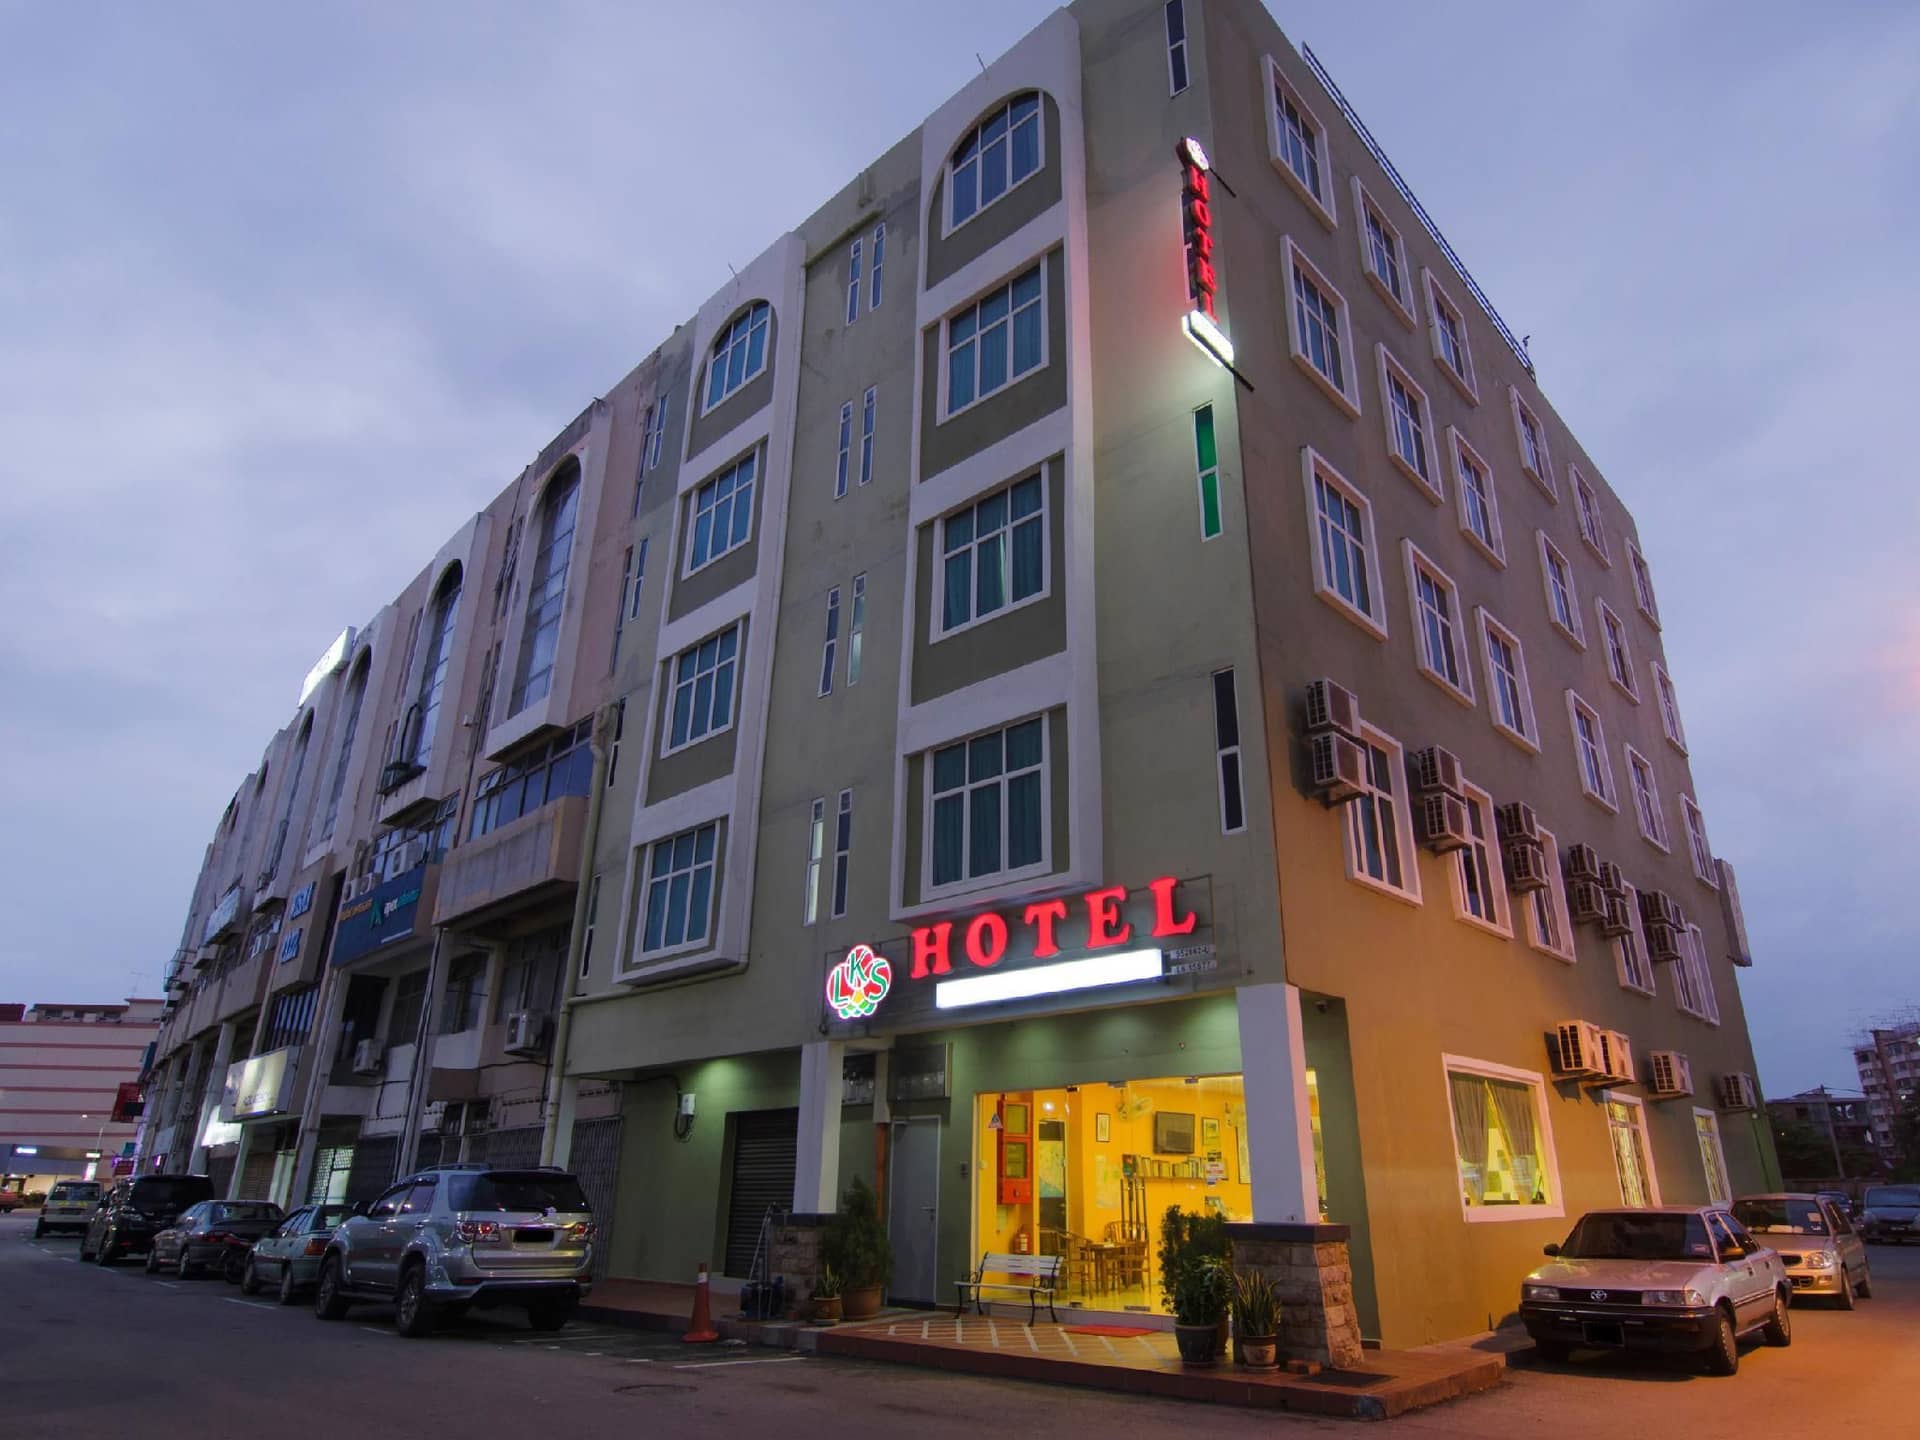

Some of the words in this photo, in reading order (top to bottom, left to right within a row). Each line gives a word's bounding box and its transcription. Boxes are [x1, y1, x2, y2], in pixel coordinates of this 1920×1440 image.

[1190, 166, 1218, 322] HOTEL
[831, 948, 889, 1004] LKS
[910, 878, 1195, 978] HOTEL
